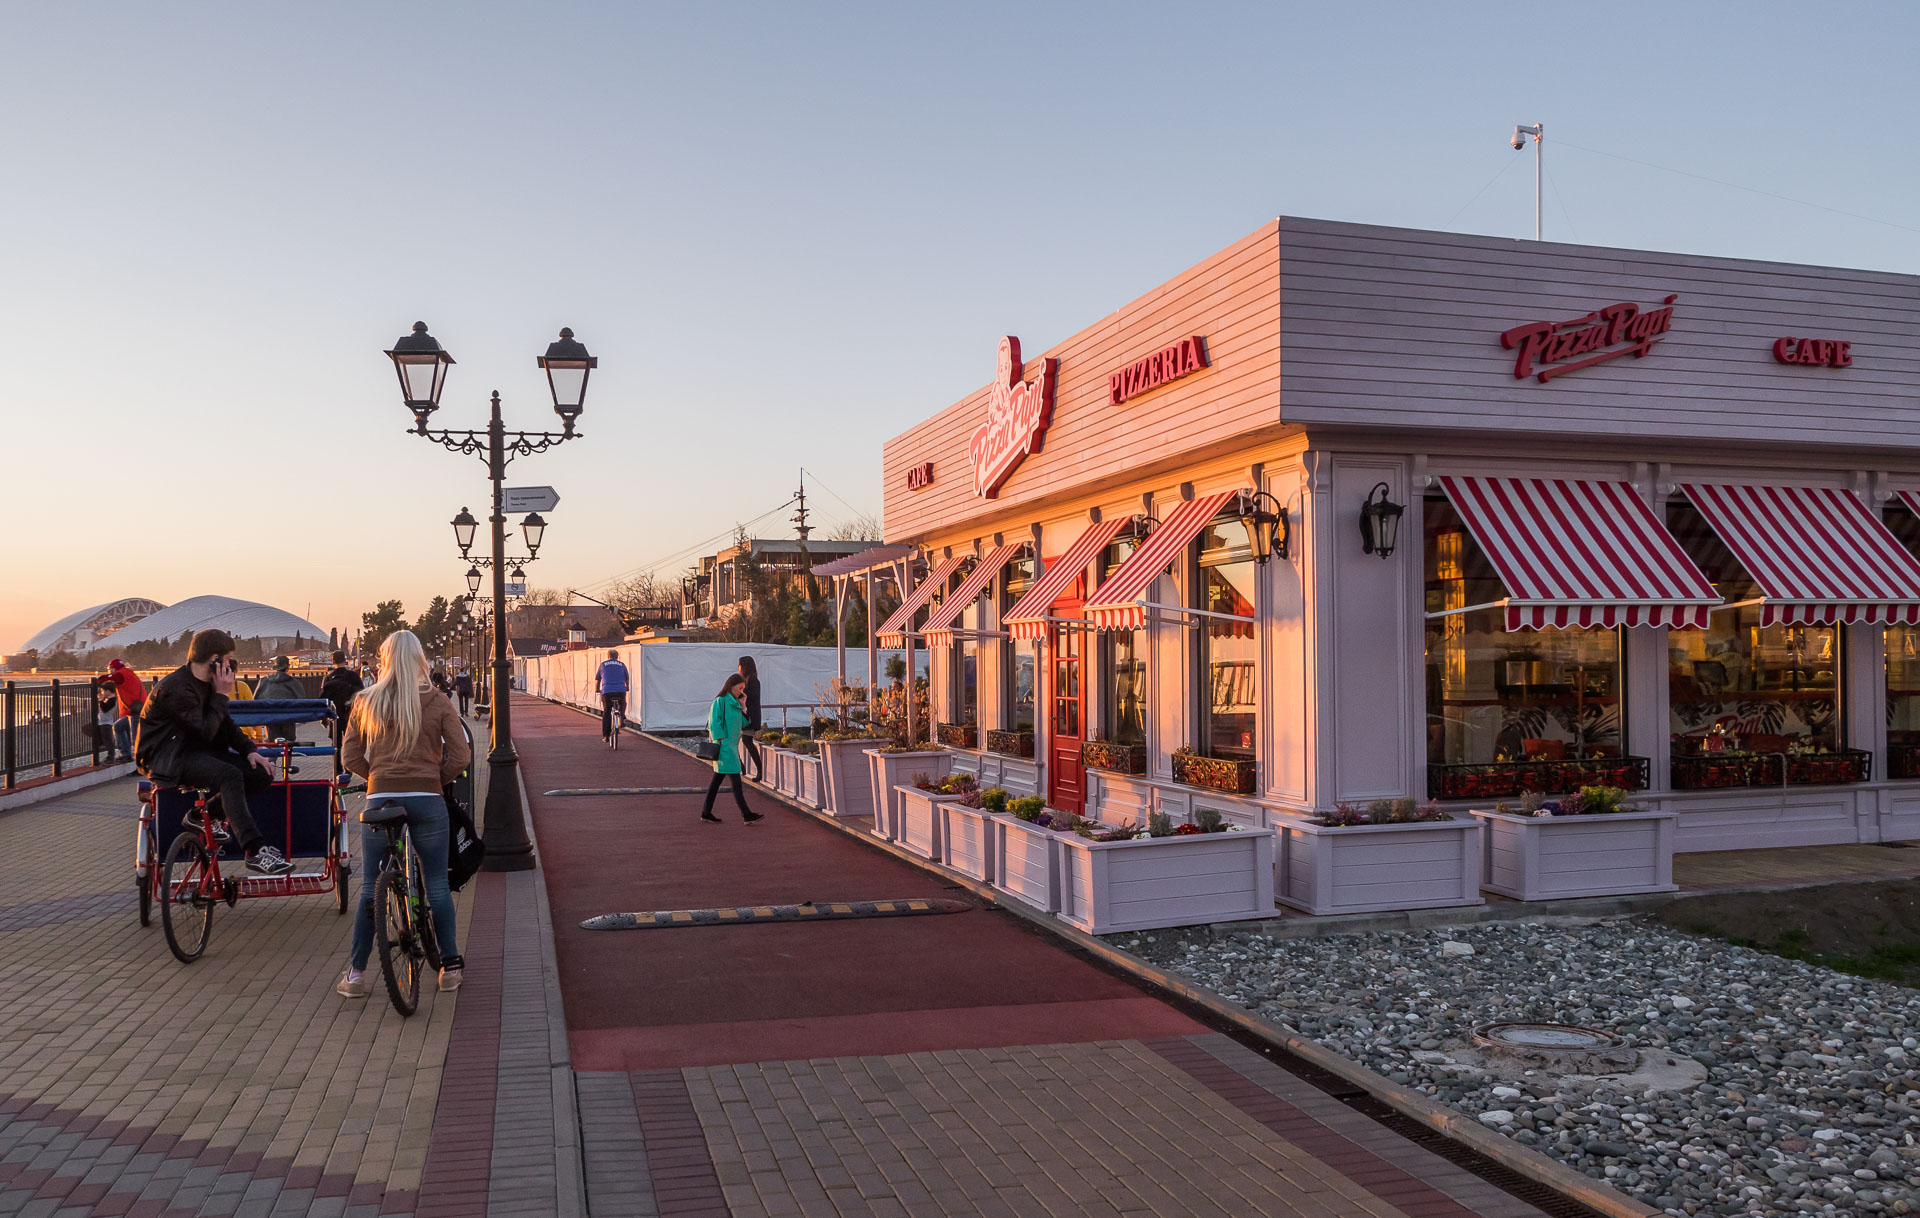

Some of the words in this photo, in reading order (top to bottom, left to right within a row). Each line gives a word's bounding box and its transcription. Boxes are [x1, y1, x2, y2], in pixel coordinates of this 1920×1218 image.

[1108, 336, 1204, 406] PIZZERIA
[1501, 312, 1608, 379] Pizza
[1600, 294, 1678, 359] Papi
[1773, 336, 1852, 367] CAFE
[969, 418, 1011, 496] Pizza
[1009, 358, 1047, 454] Papi
[907, 462, 931, 491] CAFE
